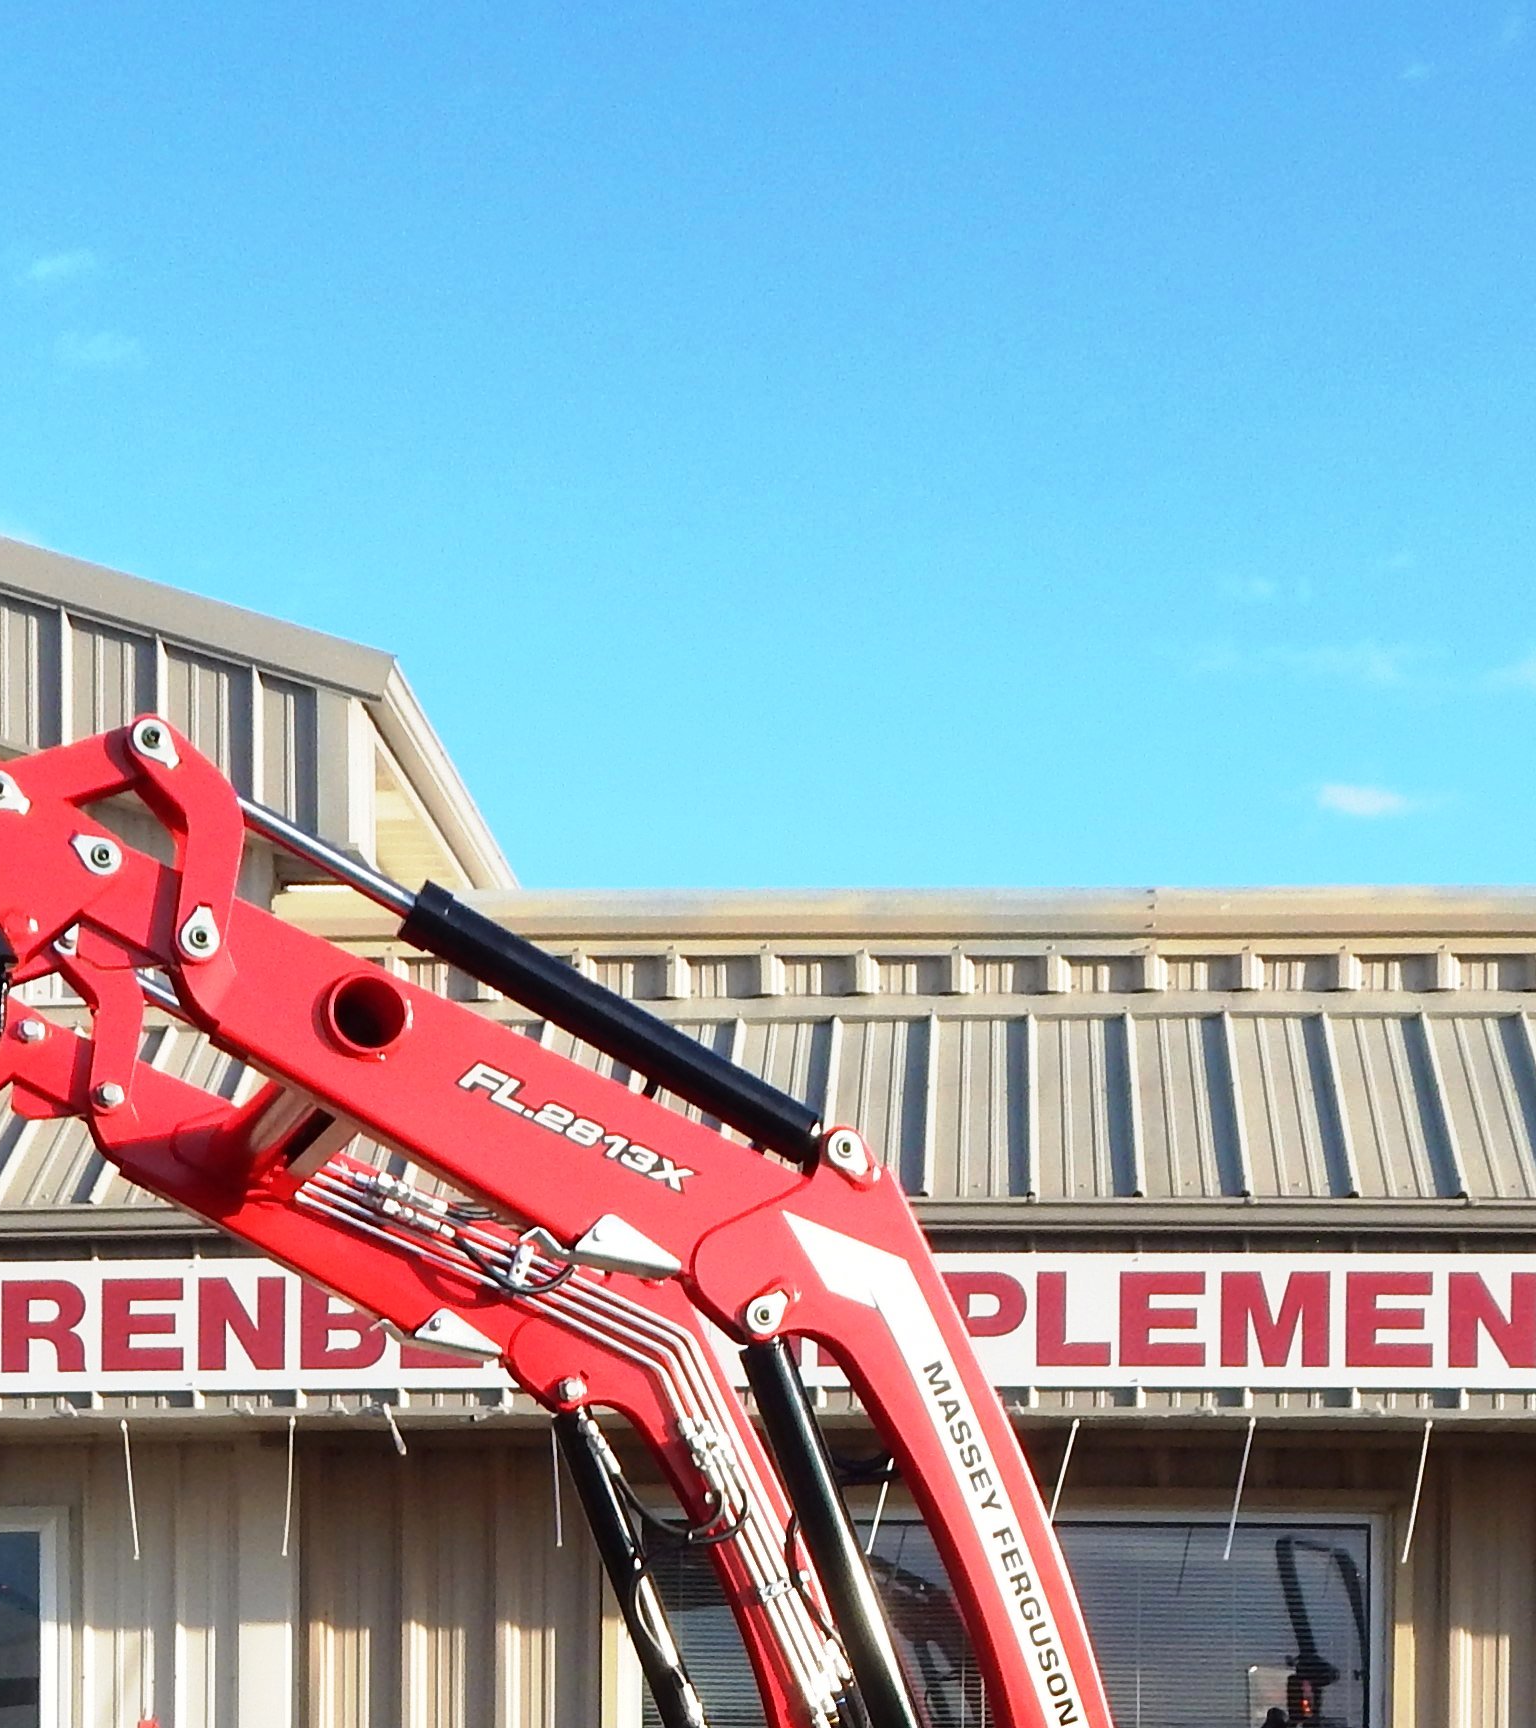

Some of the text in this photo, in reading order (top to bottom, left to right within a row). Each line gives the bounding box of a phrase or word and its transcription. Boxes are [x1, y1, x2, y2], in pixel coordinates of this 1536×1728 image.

[455, 1060, 701, 1194] FL.2813X
[923, 1360, 1079, 1727] MASSEY FERGUSON
